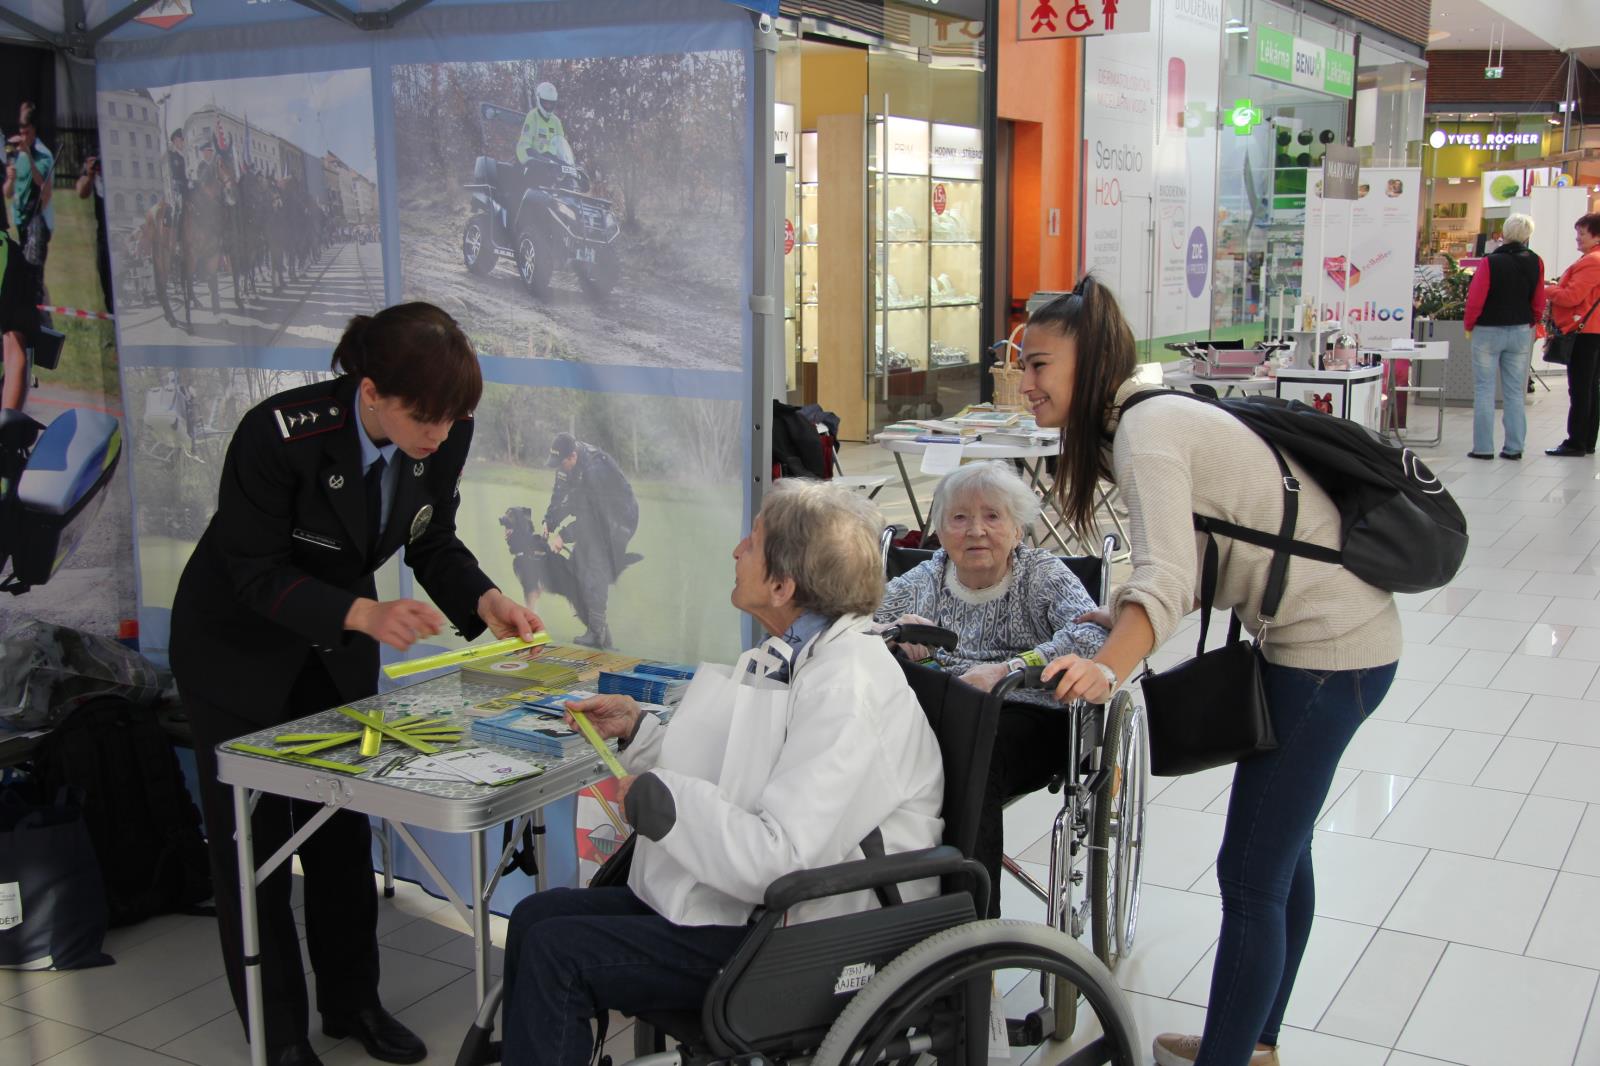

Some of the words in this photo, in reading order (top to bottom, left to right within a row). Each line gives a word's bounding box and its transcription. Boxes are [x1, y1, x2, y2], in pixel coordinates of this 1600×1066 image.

[1261, 40, 1290, 69] Lékárna
[1296, 52, 1314, 76] BENU
[1448, 134, 1480, 144] YVES
[1486, 134, 1539, 144] ROCHER
[1096, 140, 1142, 172] Sensibio
[1327, 161, 1345, 184] MARY
[1345, 163, 1358, 184] KAY
[1095, 177, 1120, 206] H2O
